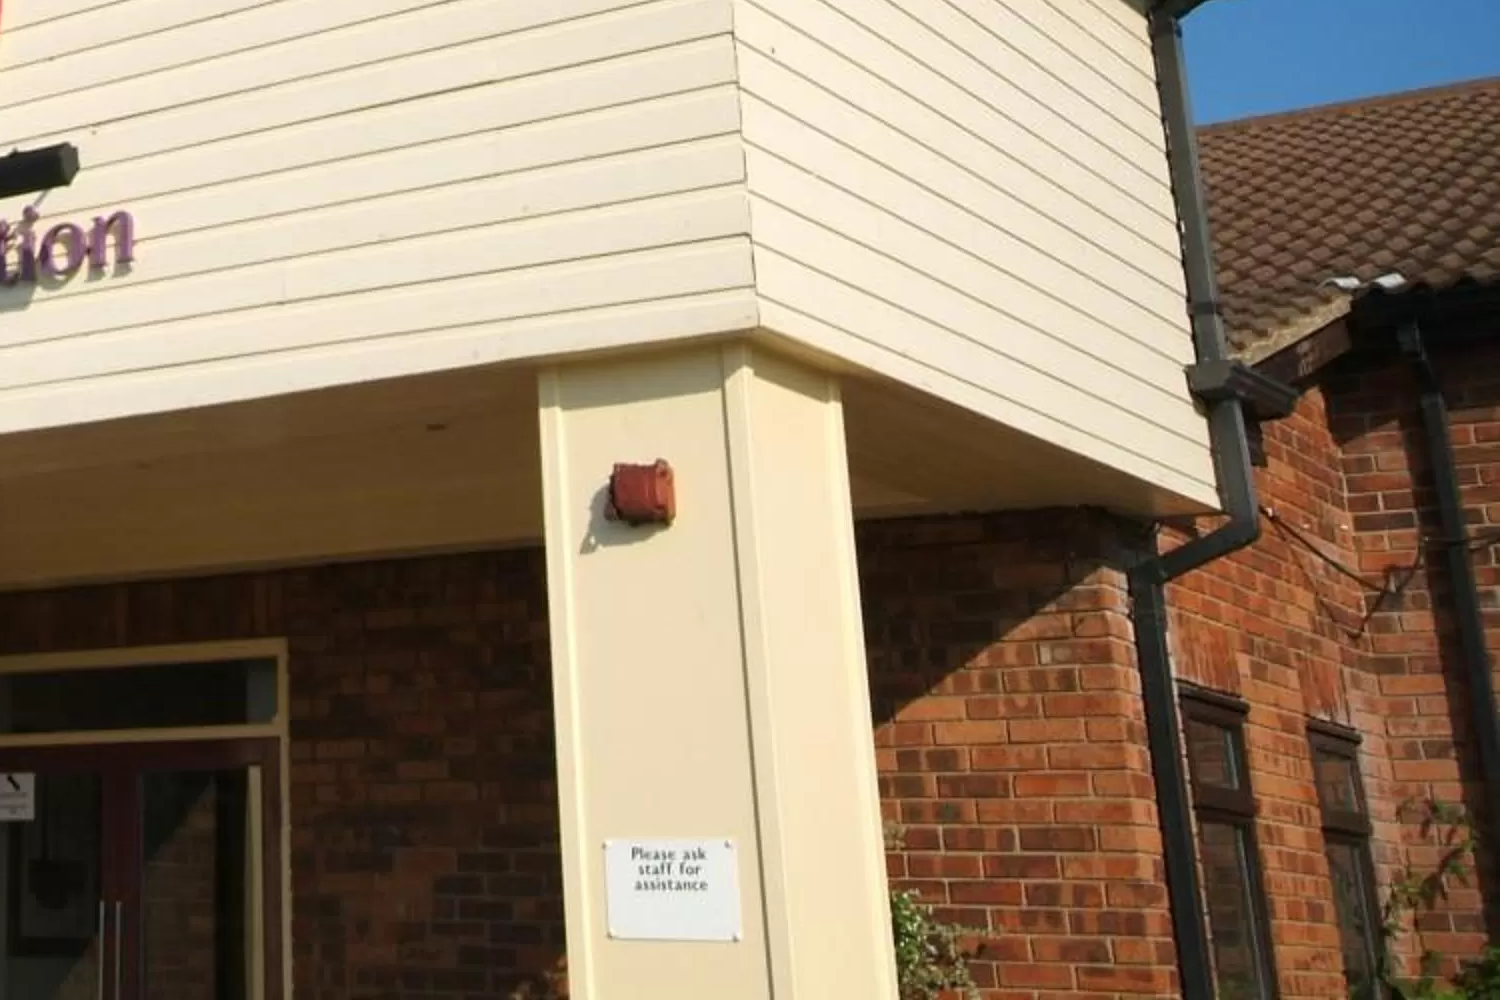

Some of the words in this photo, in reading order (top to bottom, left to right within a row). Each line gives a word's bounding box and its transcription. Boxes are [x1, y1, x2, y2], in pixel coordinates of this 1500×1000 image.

[631, 847, 676, 860] Please
[683, 846, 706, 860] ask
[638, 862, 672, 875] staff
[680, 862, 701, 875] for
[635, 880, 708, 891] assistance
